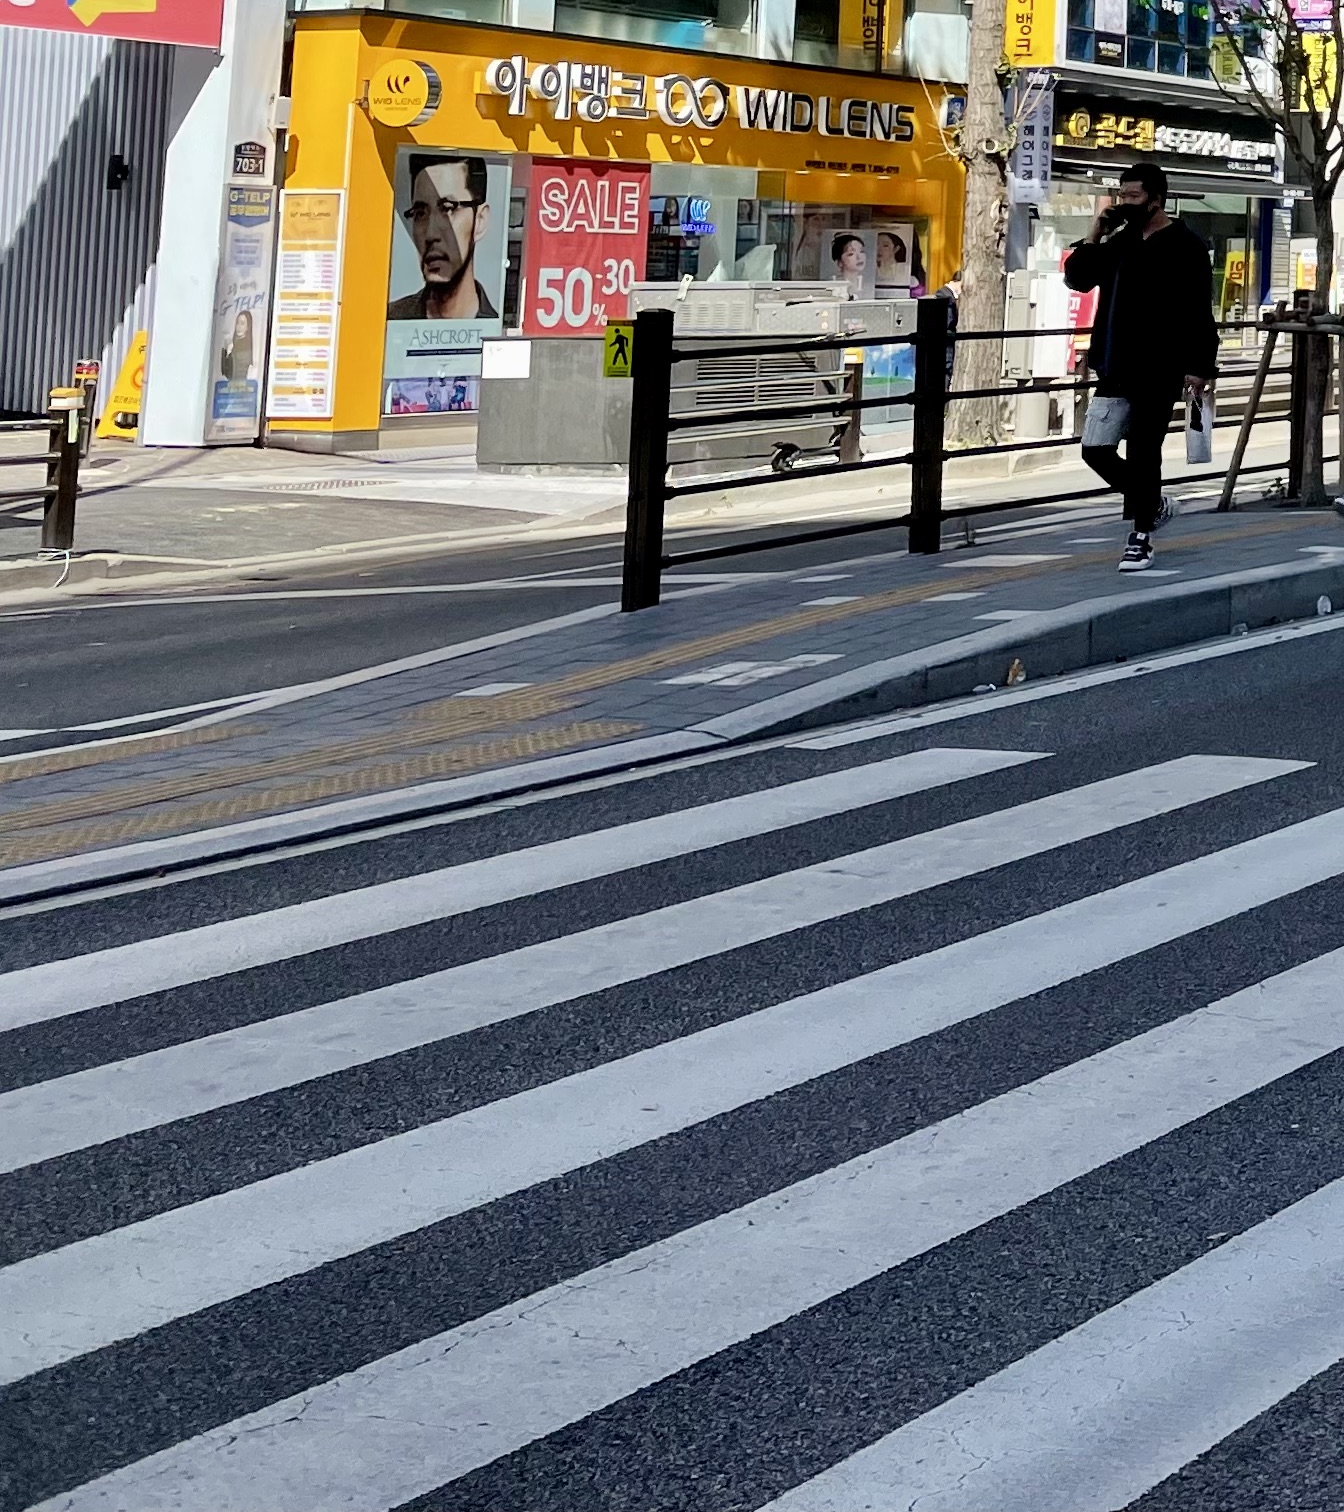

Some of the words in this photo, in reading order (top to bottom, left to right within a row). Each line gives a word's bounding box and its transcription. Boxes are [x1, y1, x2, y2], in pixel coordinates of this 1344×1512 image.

[486, 54, 650, 123] 아이뱅크
[737, 86, 814, 135] WID
[818, 96, 916, 144] LENS
[235, 156, 265, 173] 703-1
[229, 190, 271, 203] G-TELP
[538, 177, 641, 234] SALE
